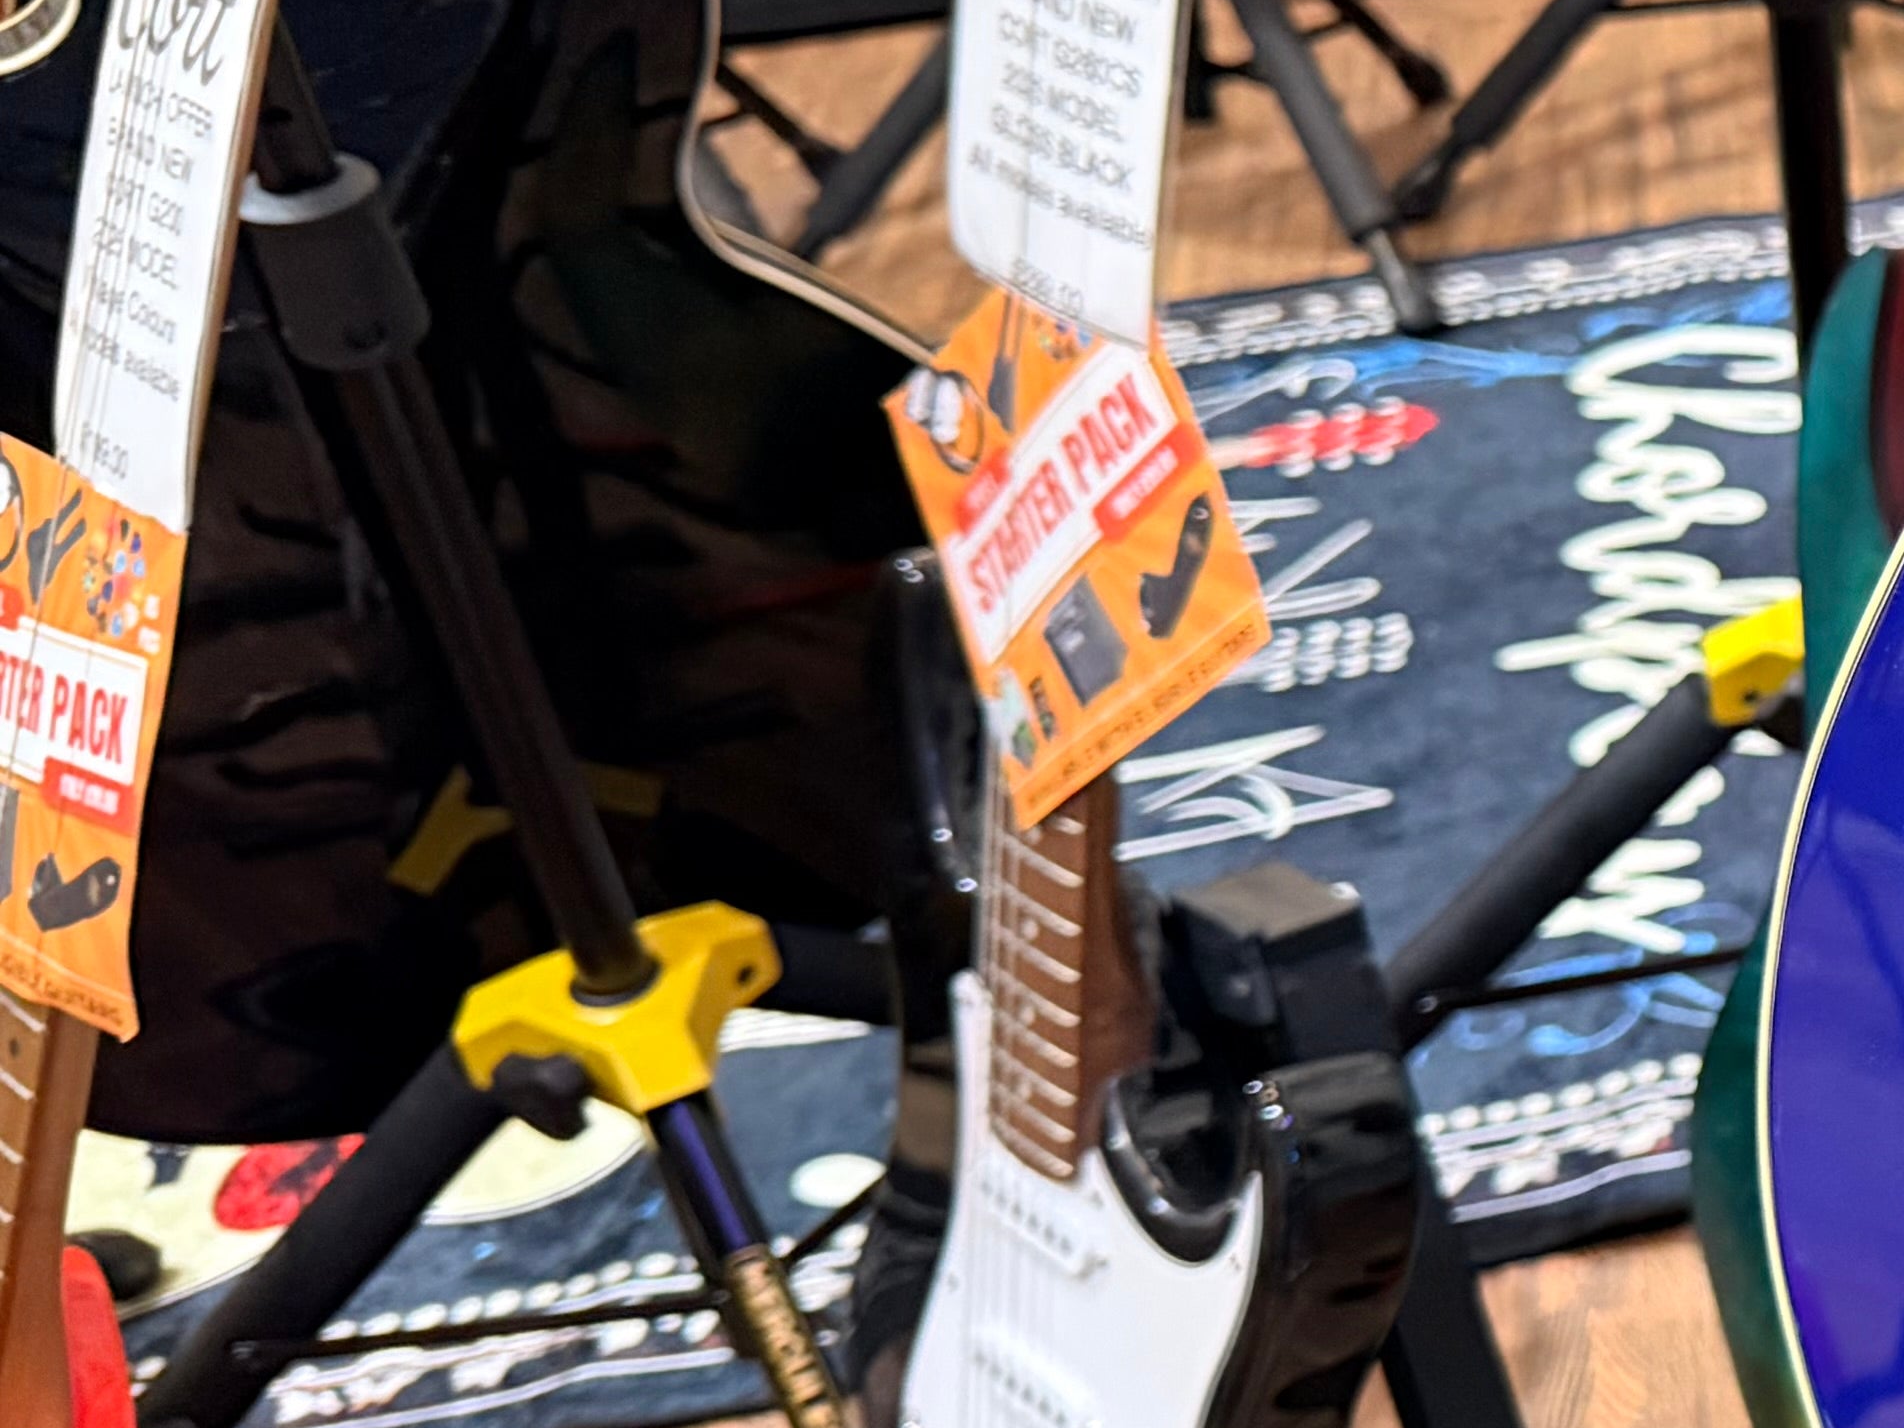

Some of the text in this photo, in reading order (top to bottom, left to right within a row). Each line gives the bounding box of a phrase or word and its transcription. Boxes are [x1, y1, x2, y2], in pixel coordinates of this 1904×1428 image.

[966, 457, 1073, 615] STARTER
[1060, 371, 1160, 498] PACK
[49, 672, 129, 766] PACK
